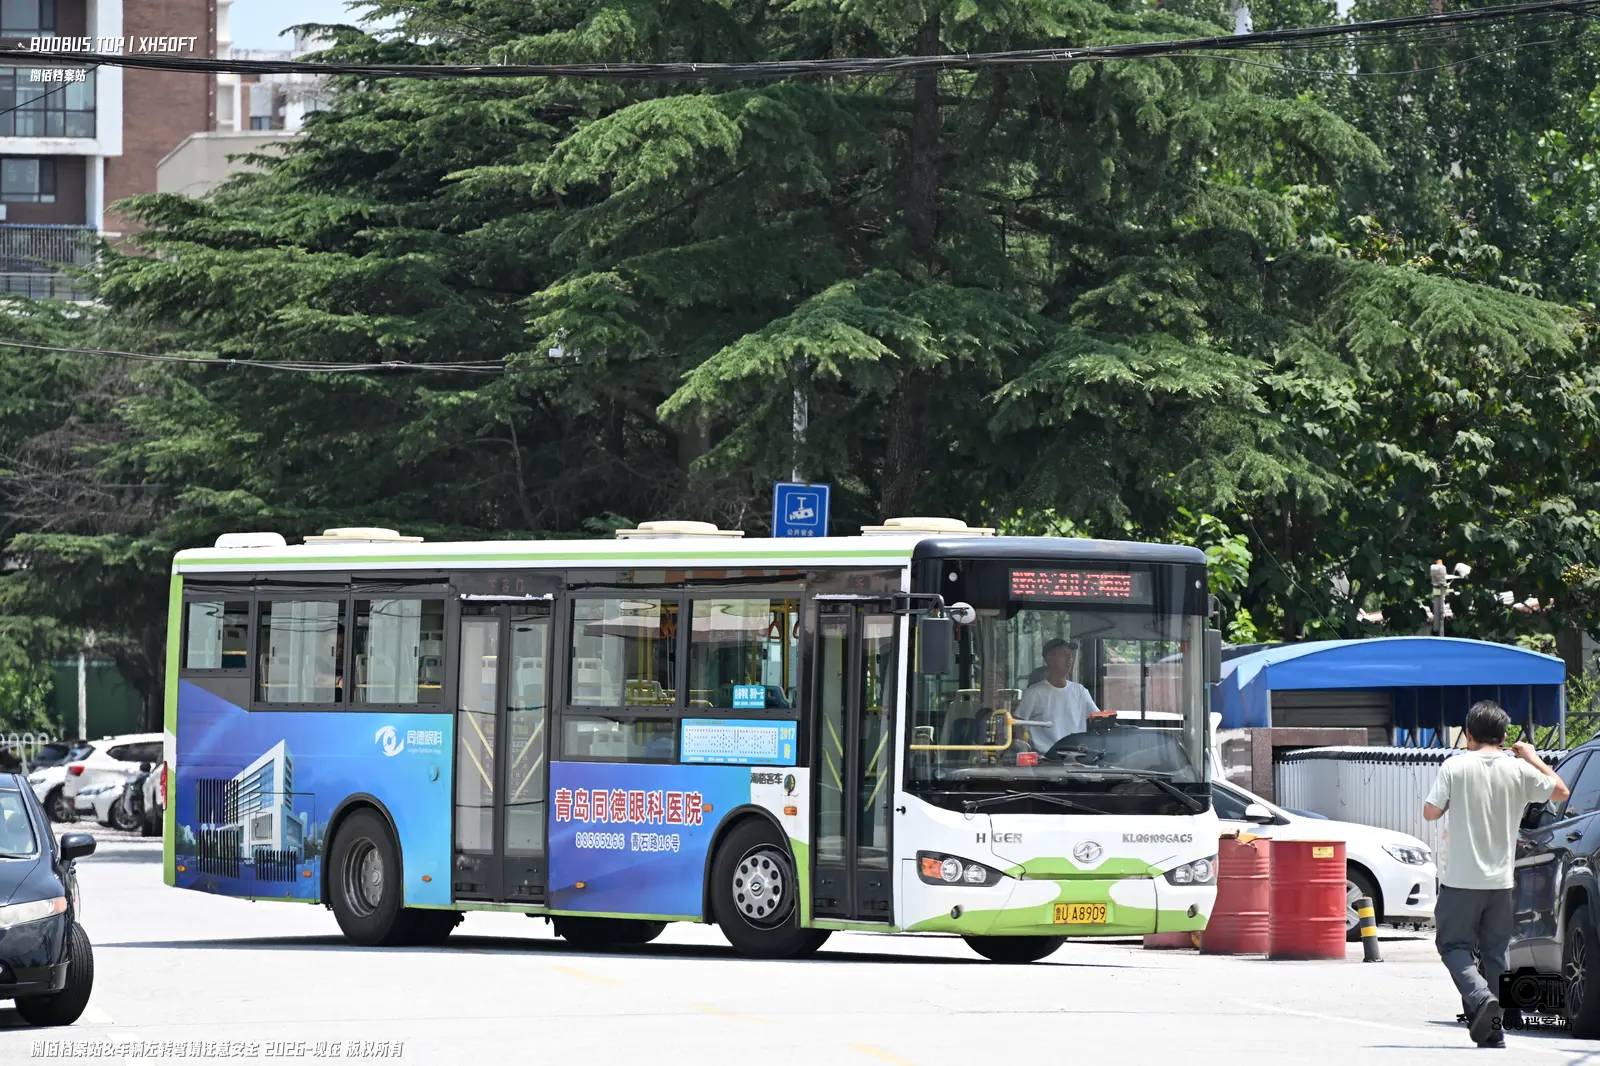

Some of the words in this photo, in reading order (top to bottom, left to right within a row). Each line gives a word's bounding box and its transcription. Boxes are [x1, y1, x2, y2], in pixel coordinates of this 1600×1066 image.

[555, 787, 704, 826] 青岛同德眼科医院
[575, 832, 626, 850] 88565266
[630, 833, 681, 852] 青石路16号
[976, 832, 1023, 844] HGER
[1122, 833, 1193, 843] KLQ6109GAC5
